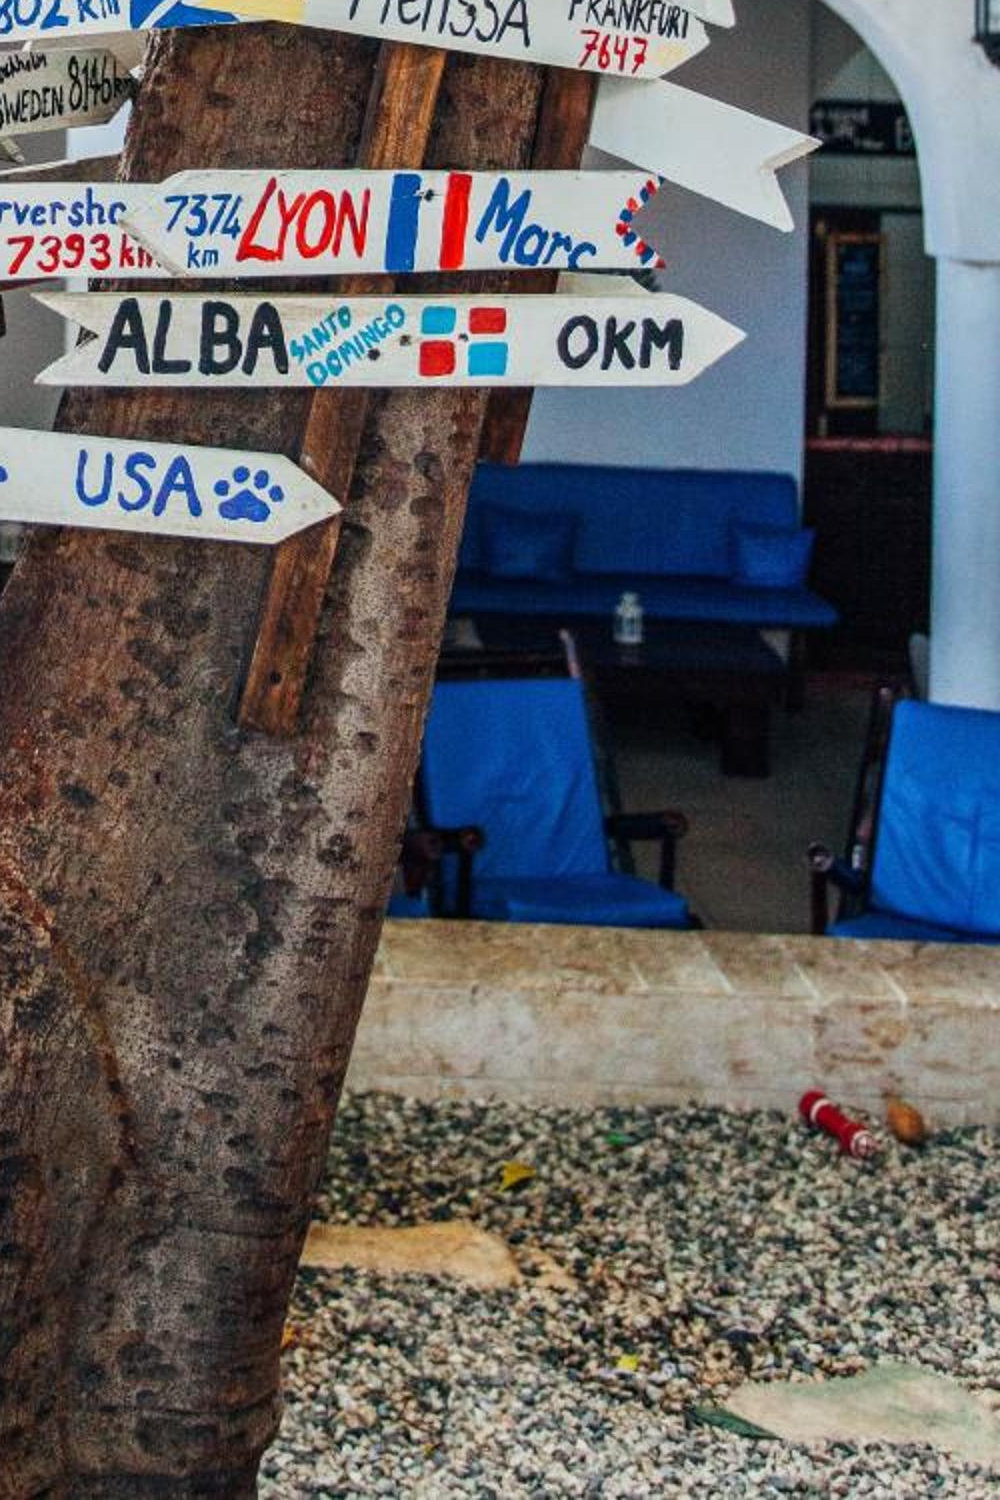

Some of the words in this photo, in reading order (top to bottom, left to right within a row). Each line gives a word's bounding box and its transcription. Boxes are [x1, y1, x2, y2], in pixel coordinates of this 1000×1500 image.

[579, 29, 648, 74] 7647
[6, 233, 113, 276] 7393
[164, 192, 244, 239] 7374
[235, 176, 372, 262] LYON
[475, 177, 597, 269] Marc
[186, 241, 220, 268] km
[97, 297, 290, 375] ALBA
[289, 305, 352, 364] SANTO
[306, 303, 406, 388] DOMINGO
[75, 448, 203, 518] USA
